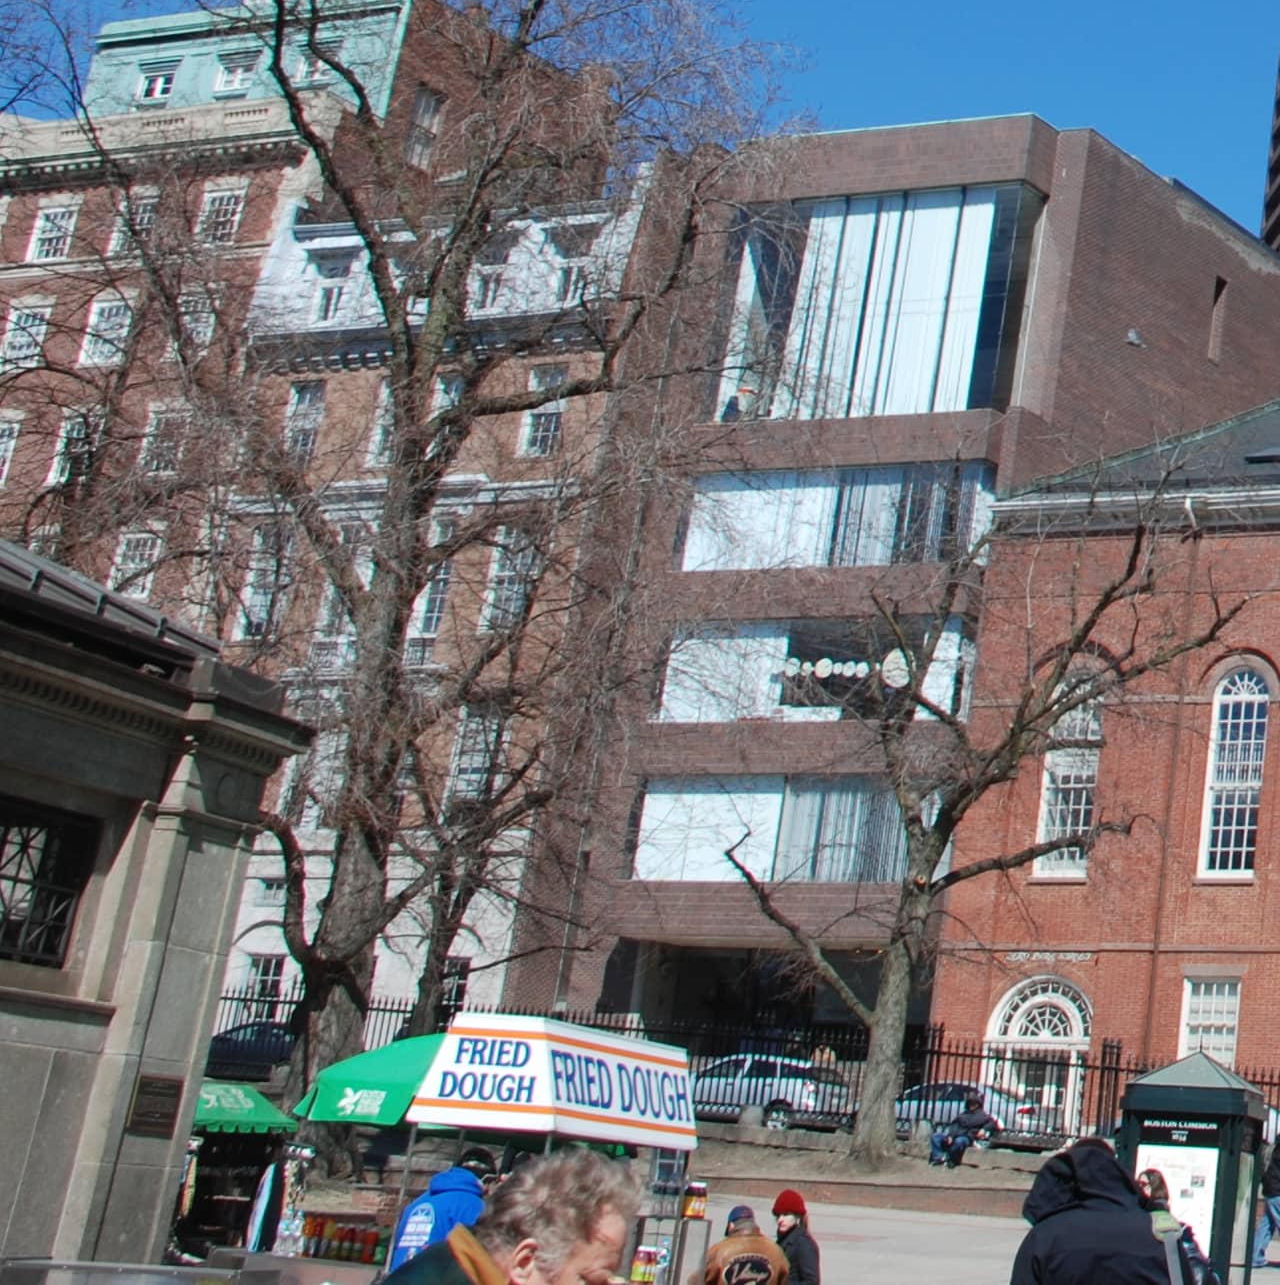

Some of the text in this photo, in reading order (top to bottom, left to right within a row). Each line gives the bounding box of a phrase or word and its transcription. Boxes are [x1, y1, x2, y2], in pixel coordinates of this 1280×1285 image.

[454, 1037, 531, 1068] FRIED
[438, 1070, 537, 1103] DOUGH
[551, 1049, 691, 1122] FRIED DOUGH
